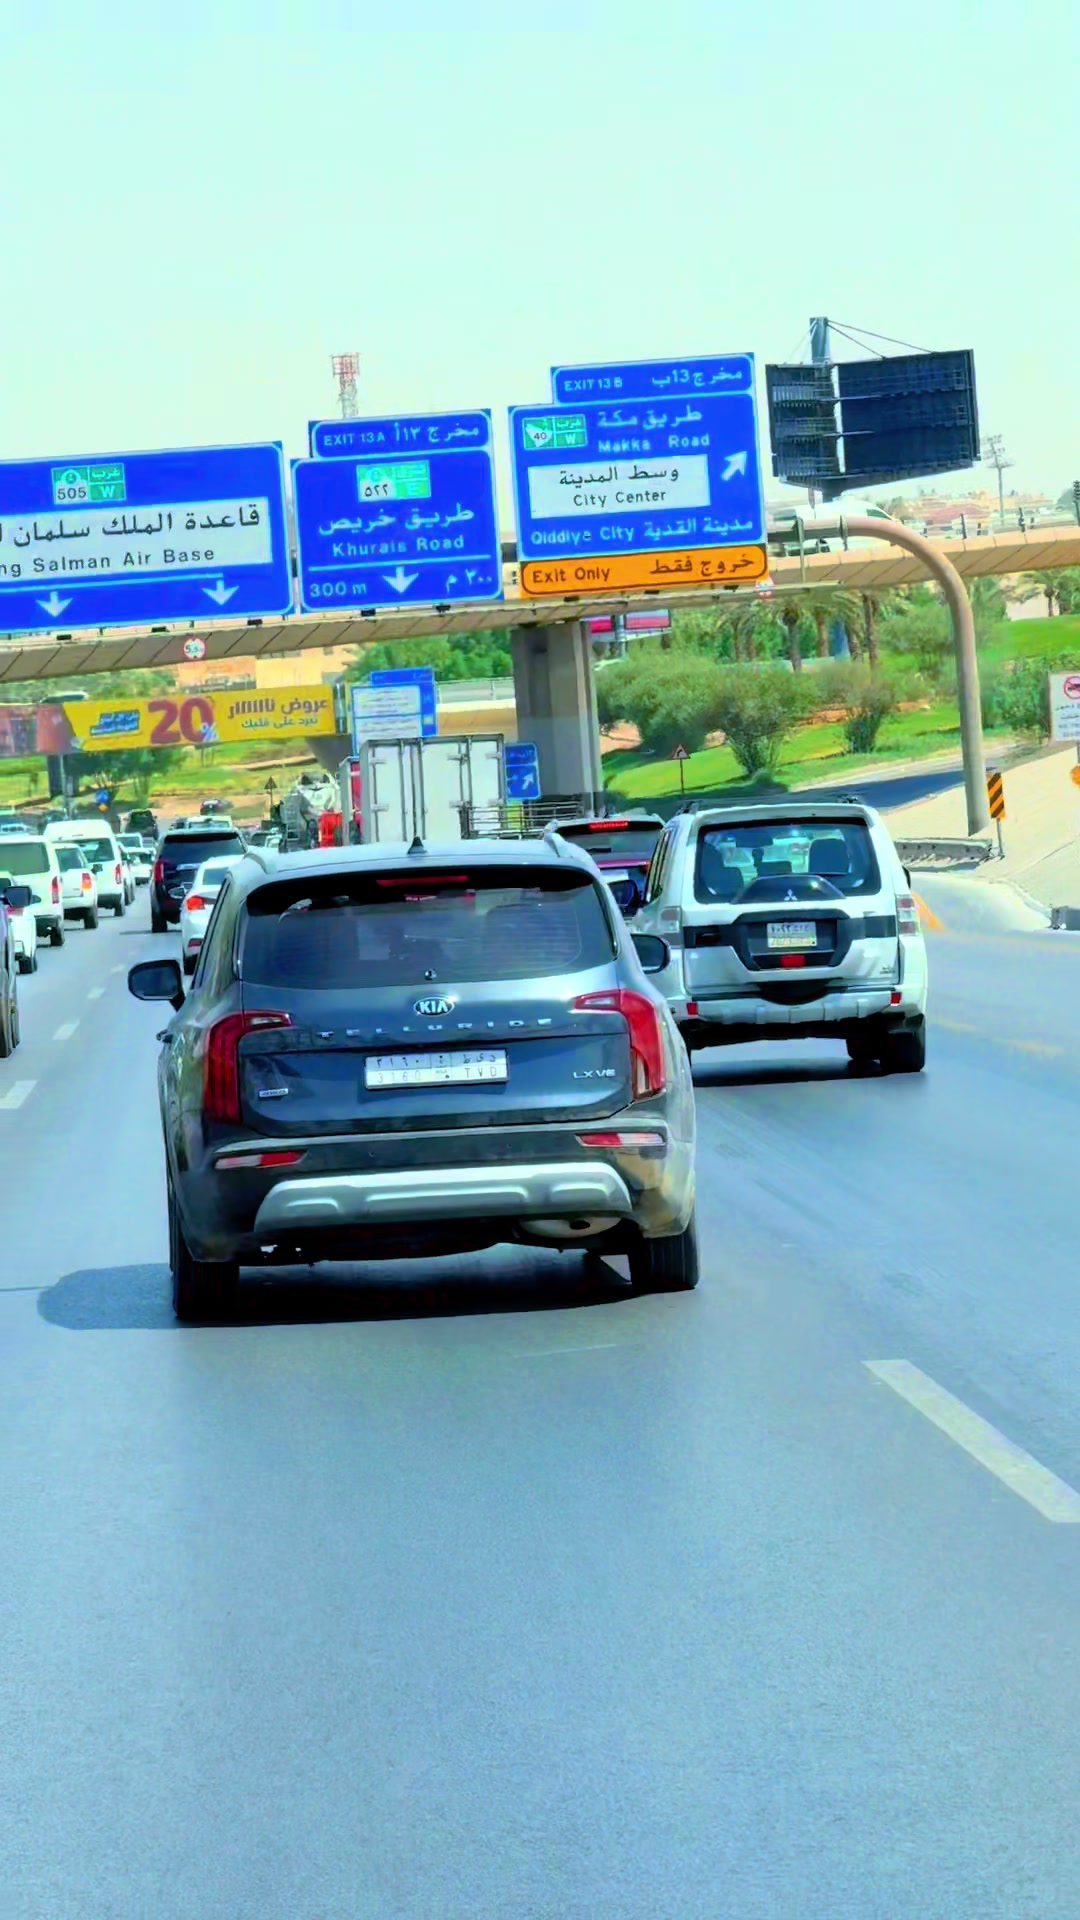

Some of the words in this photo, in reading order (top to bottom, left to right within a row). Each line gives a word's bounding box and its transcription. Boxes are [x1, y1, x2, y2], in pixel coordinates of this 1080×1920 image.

[564, 379, 594, 391] EXIT
[693, 367, 743, 387] مخرج
[597, 409, 638, 427] مكة
[643, 404, 703, 430] طريق
[324, 434, 354, 446] EXIT
[428, 422, 479, 443] مخرج
[533, 431, 548, 440] 40
[564, 432, 576, 445] W
[668, 433, 709, 449] Road
[559, 466, 618, 488] المدينة
[627, 465, 679, 481] وسط
[57, 486, 87, 500] 505
[100, 484, 116, 498] W
[573, 493, 607, 507] City
[615, 490, 666, 503] Center
[102, 512, 173, 536] الملك
[185, 503, 261, 530] قاعدة
[319, 508, 397, 535] خريص
[404, 502, 475, 530] طريق
[13, 519, 91, 548] سلمان
[600, 526, 635, 542] City
[703, 517, 753, 536] مدينة
[333, 539, 408, 557] Khurais
[417, 535, 465, 551] Road
[33, 553, 111, 573] Salman
[123, 551, 151, 566] Air
[163, 548, 215, 563] Base
[649, 555, 693, 574] فقط
[700, 553, 755, 577] خروج
[532, 568, 567, 584] Exit
[574, 566, 610, 582] Only
[309, 582, 347, 598] 300
[352, 582, 367, 594] m
[281, 698, 328, 715] عروض
[419, 1000, 449, 1014] KIA
